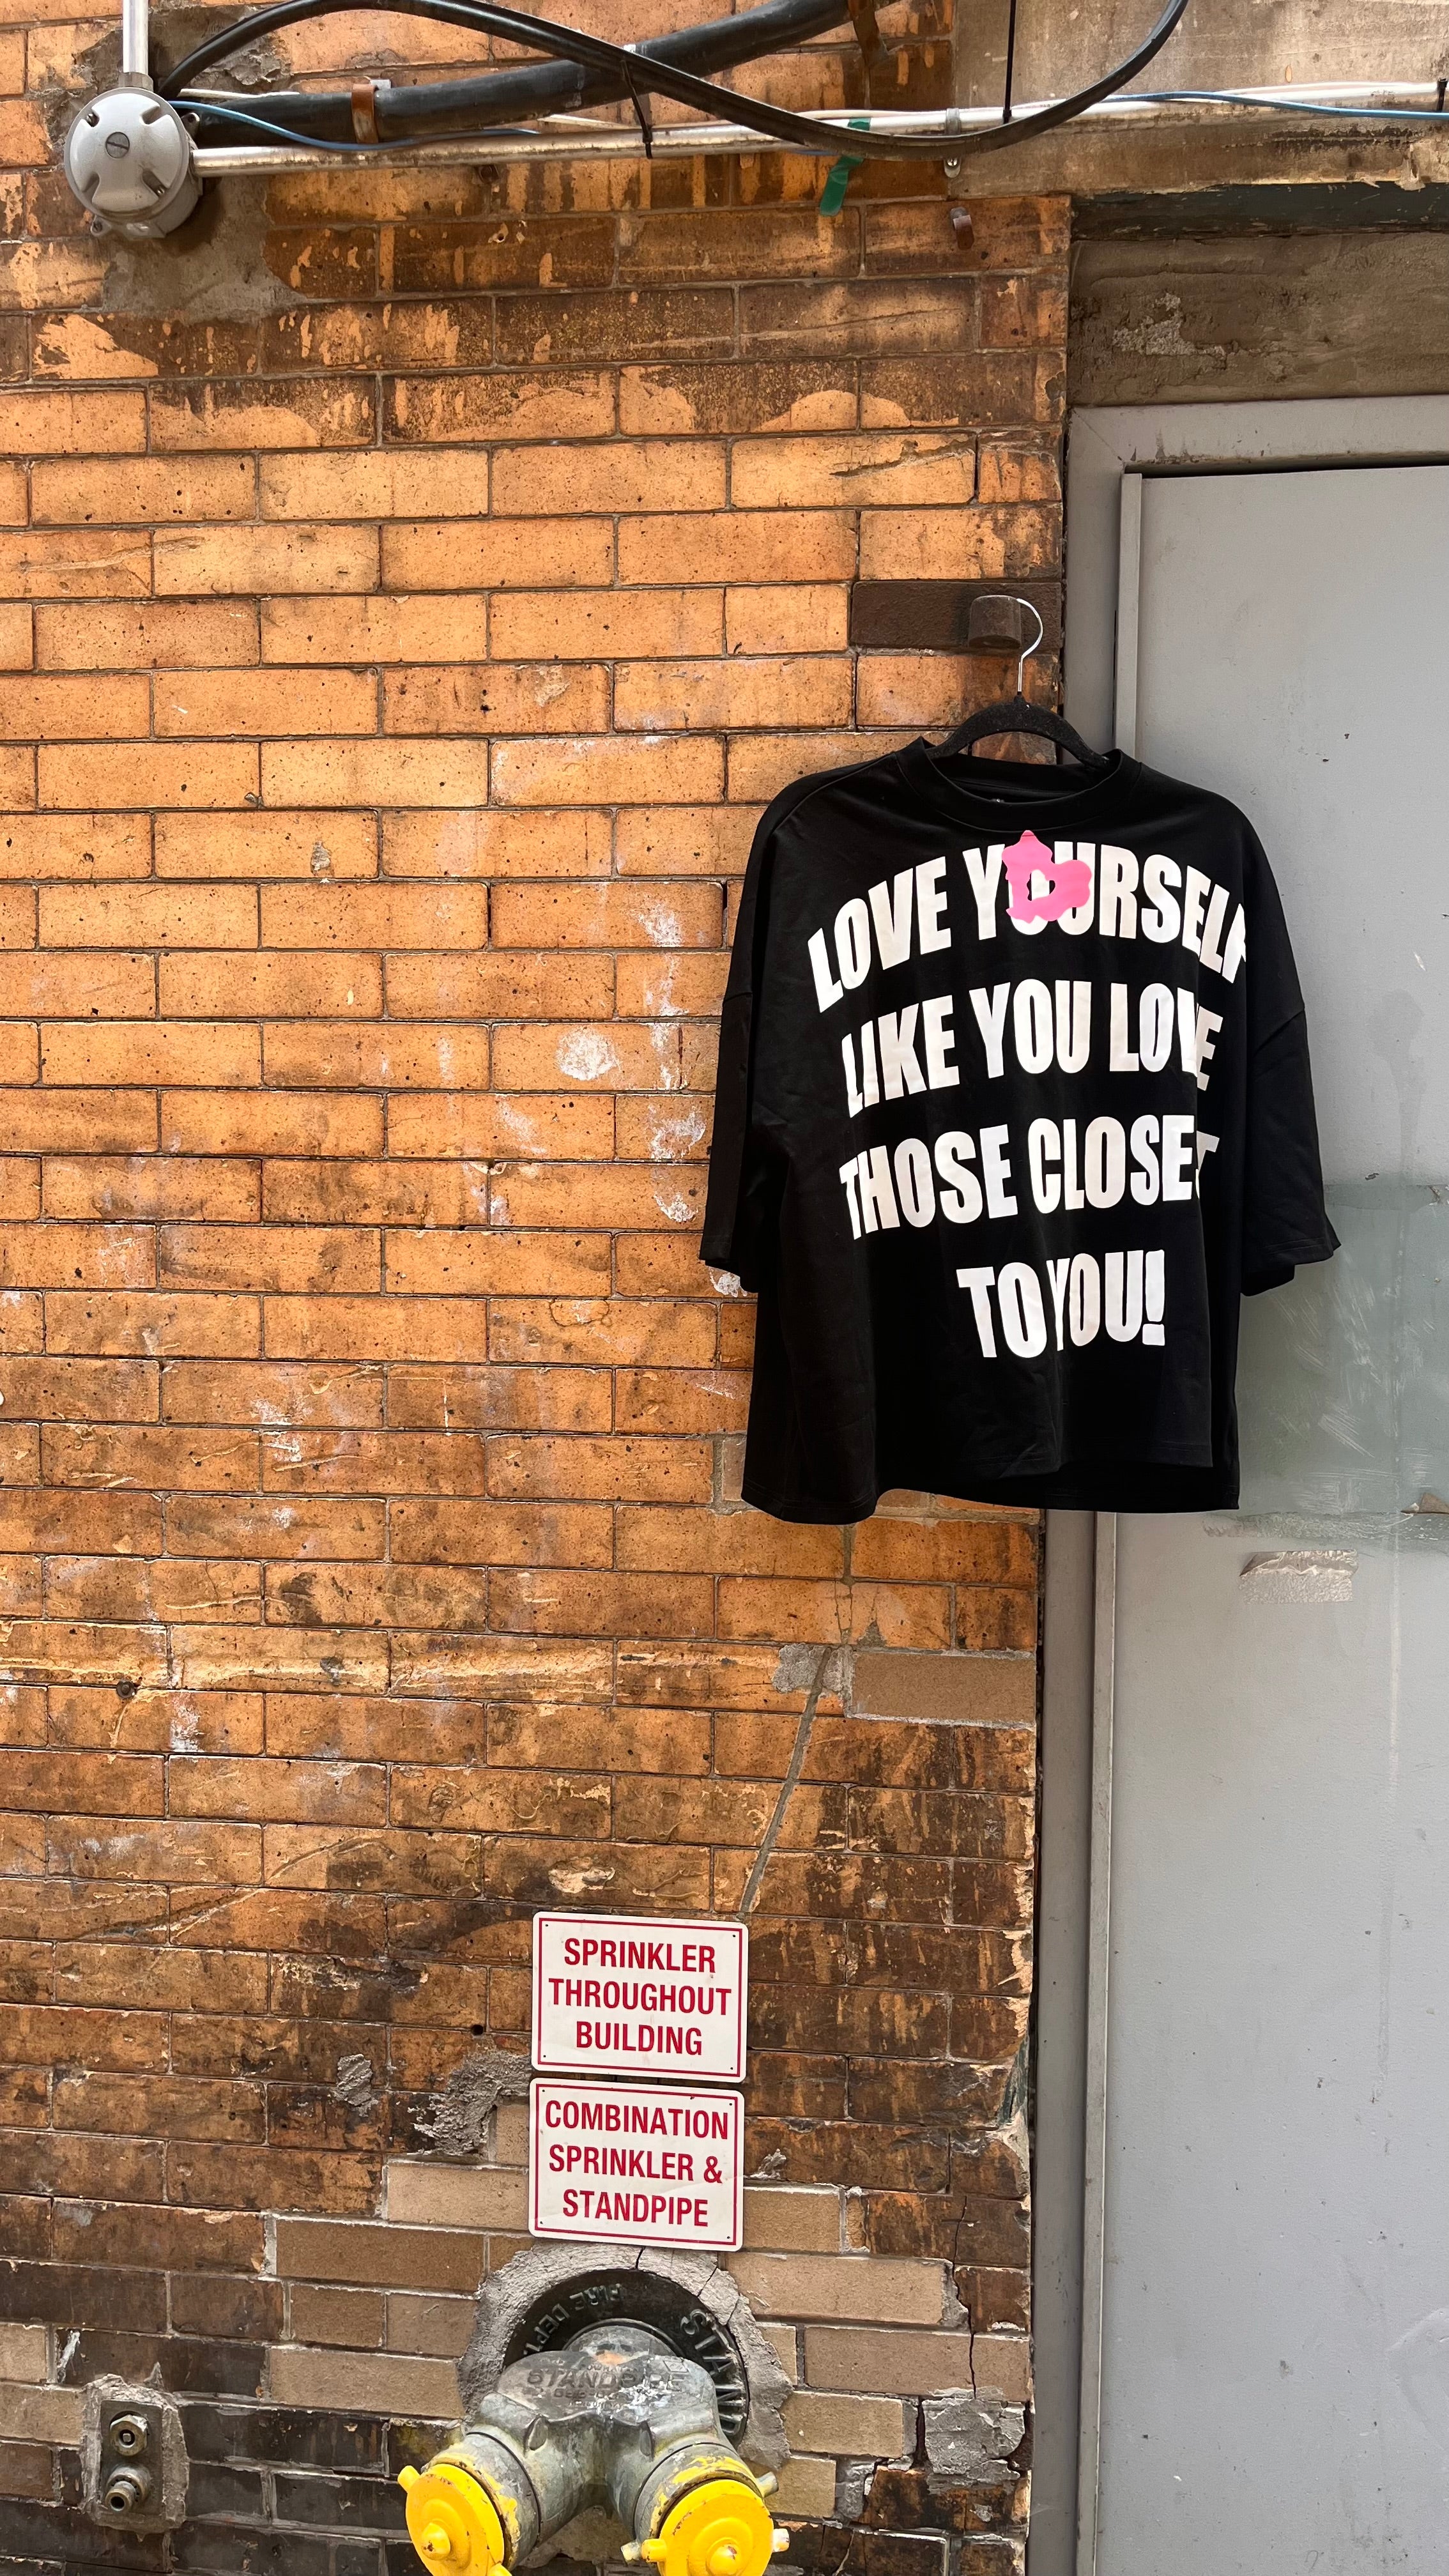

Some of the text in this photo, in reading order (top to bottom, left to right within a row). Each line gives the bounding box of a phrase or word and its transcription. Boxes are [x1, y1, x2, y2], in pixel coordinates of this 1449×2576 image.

[808, 855, 951, 1013] LOVE
[842, 979, 1223, 1119] LIKE YOU LOVE
[839, 1124, 1018, 1239] THOSE
[956, 1250, 1165, 1358] TO YOU!
[564, 1938, 716, 1974] SPRINKLER
[548, 1978, 732, 2016] THROUGHOUT
[576, 2021, 702, 2055] BUILDING
[545, 2100, 728, 2140] COMBINATION
[549, 2144, 723, 2184] SPRINKLER &
[563, 2189, 708, 2227] STANDPIPE
